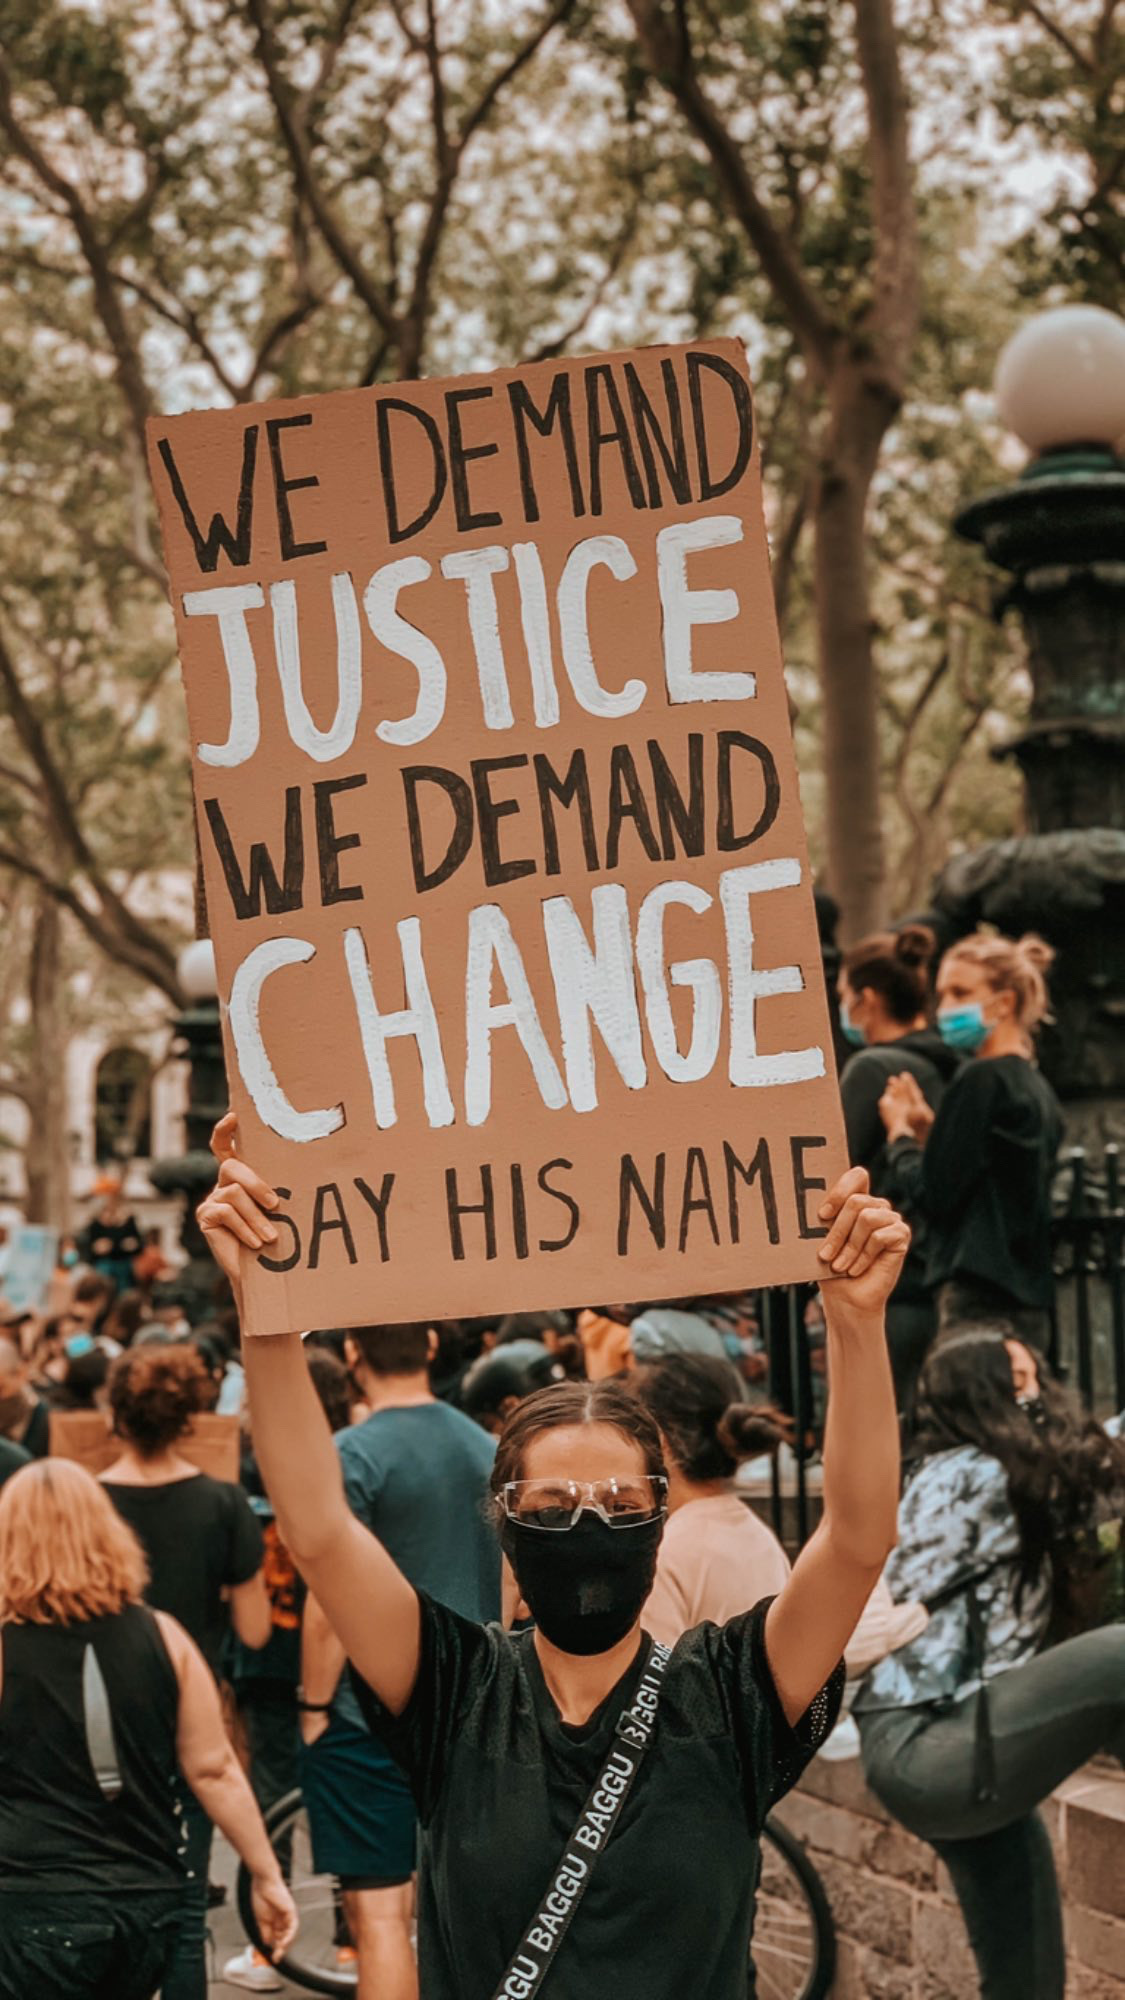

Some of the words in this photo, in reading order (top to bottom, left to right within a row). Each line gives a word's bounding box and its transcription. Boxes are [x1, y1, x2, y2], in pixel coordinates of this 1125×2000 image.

[157, 412, 328, 574] WE
[375, 351, 754, 545] DEMAND
[182, 515, 757, 768] JUSTICE
[203, 773, 368, 921] WE
[400, 730, 781, 894] DEMAND
[228, 858, 827, 1144] CHANGE
[256, 1173, 396, 1273] SAY
[445, 1157, 580, 1261] HIS
[617, 1135, 830, 1257] NAME
[526, 1853, 588, 1953] BAGGU
[574, 1751, 634, 1851] BAGGU
